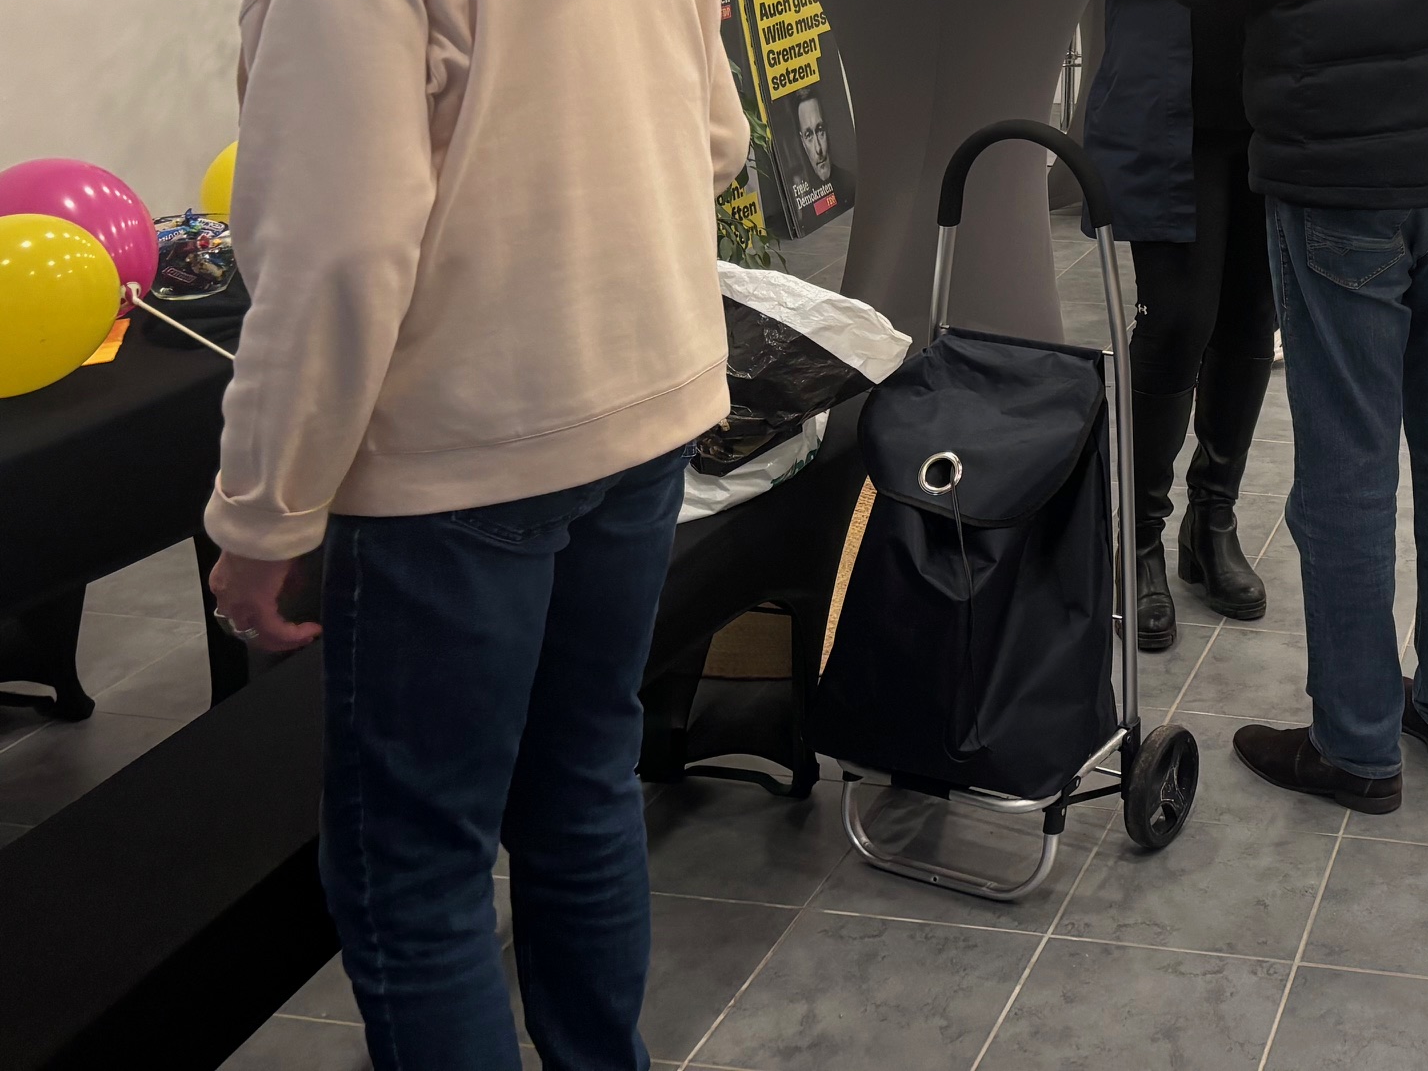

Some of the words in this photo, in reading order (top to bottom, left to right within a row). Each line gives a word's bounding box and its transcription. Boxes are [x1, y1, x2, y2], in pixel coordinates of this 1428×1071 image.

[762, 20, 794, 46] Wille
[795, 11, 827, 34] muss
[766, 37, 817, 69] Grenzen
[771, 62, 816, 91] setzen.
